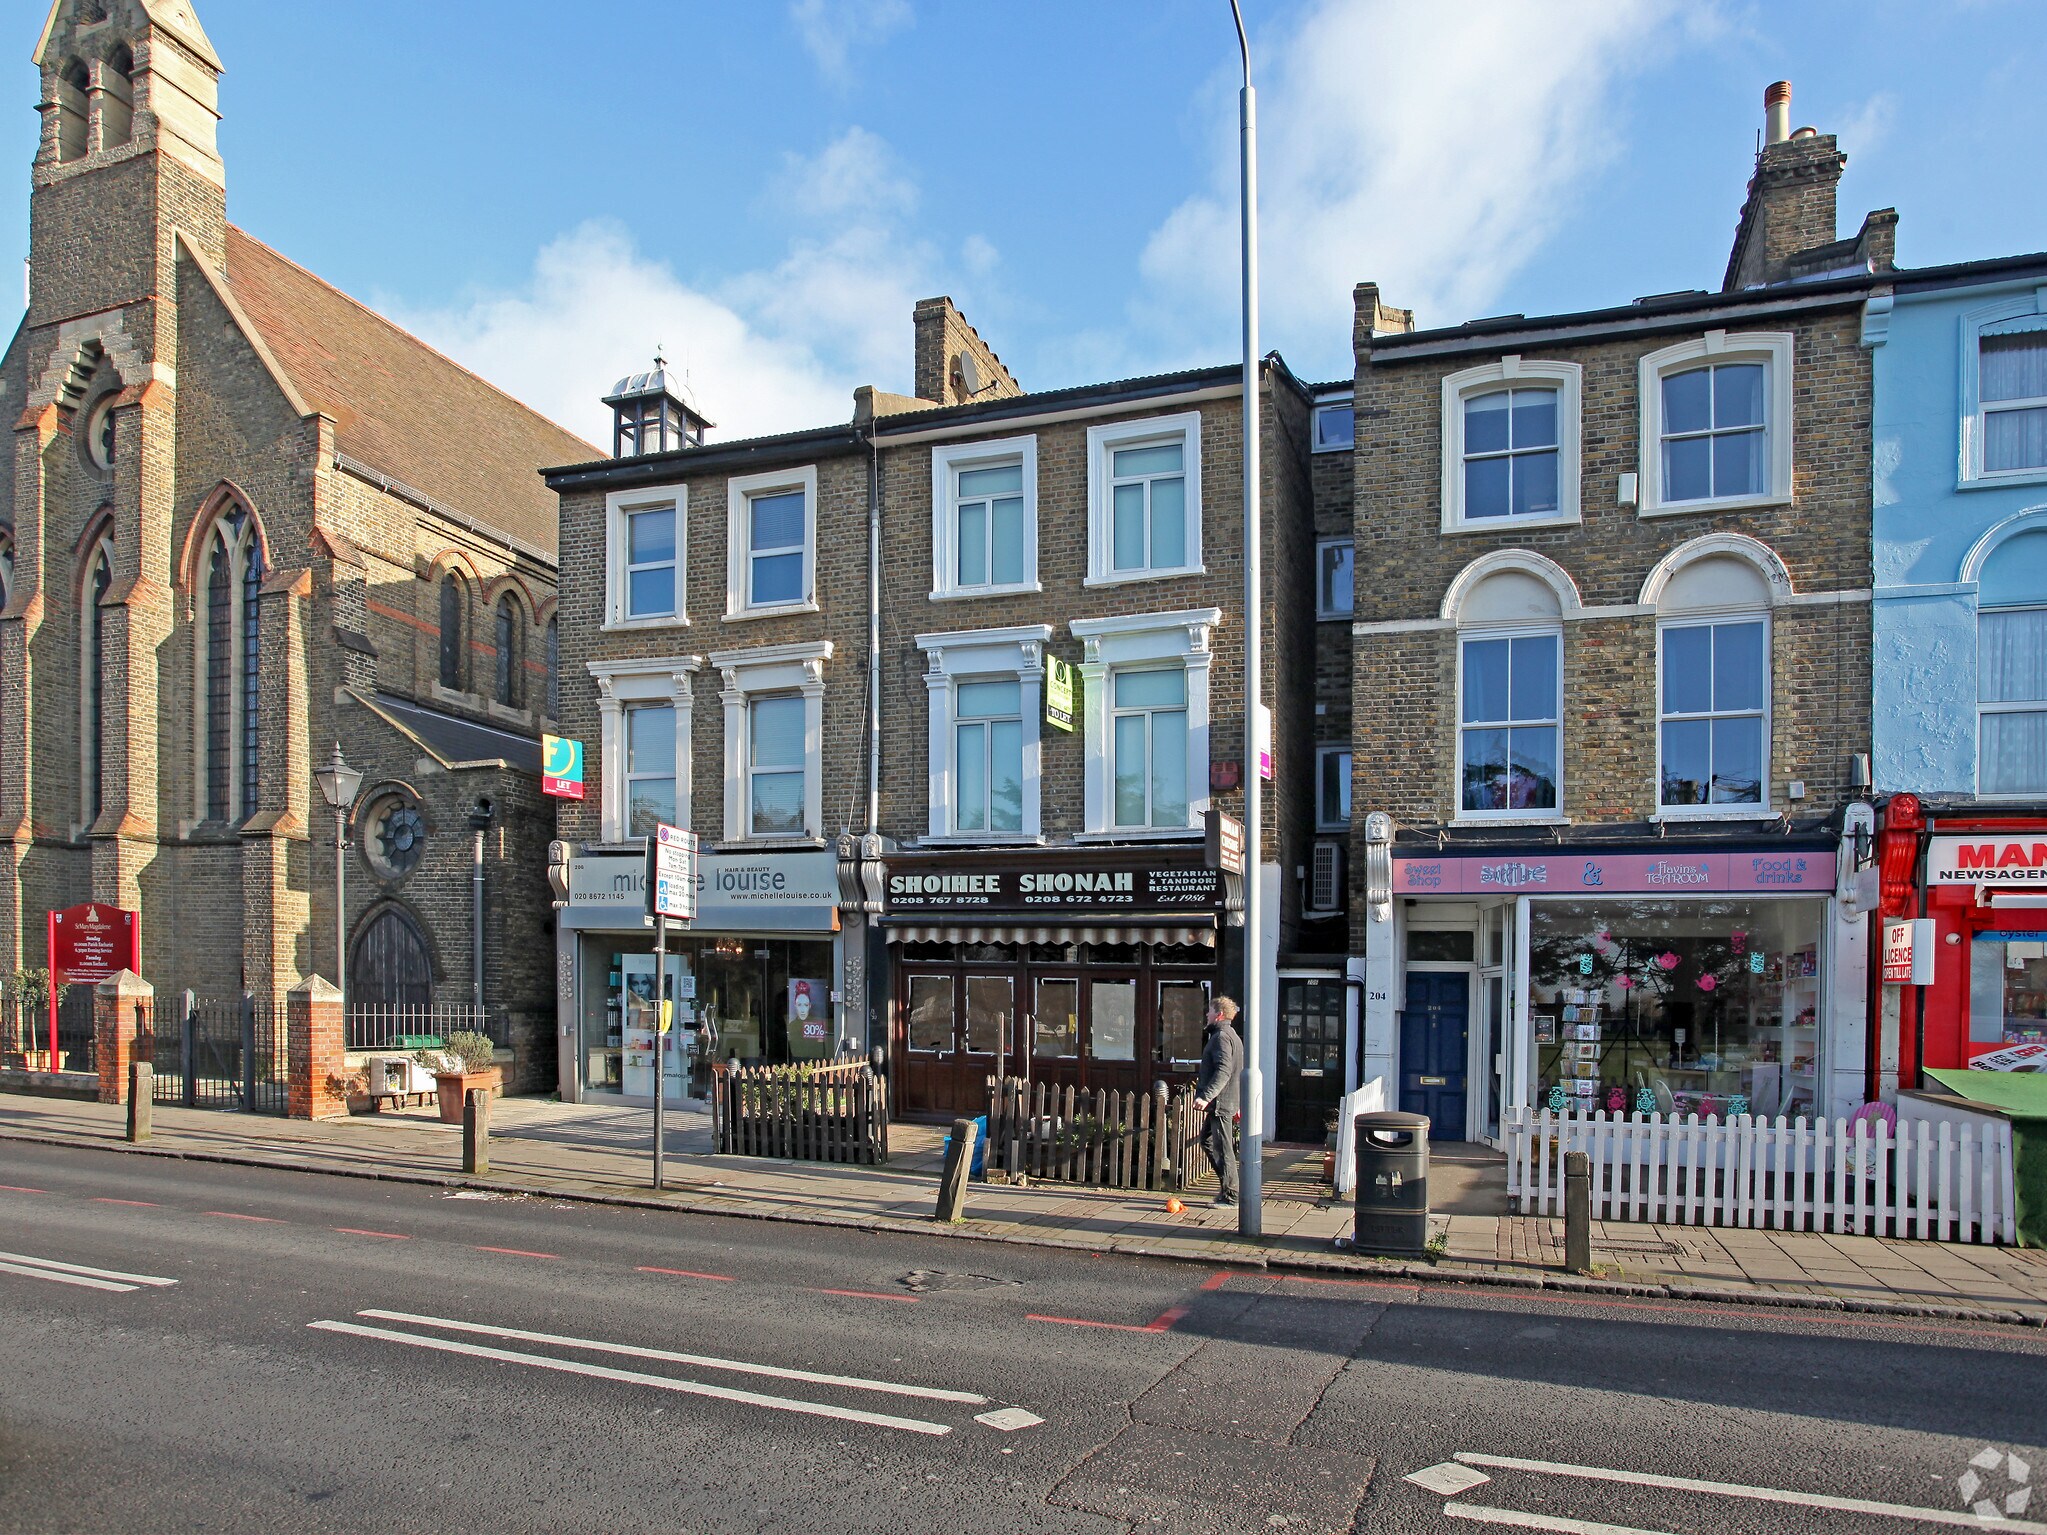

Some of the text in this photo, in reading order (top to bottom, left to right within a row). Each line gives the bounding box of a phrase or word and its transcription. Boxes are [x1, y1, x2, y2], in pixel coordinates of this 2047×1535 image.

[1051, 707, 1070, 723] TO LET
[557, 780, 571, 789] LET
[670, 834, 696, 846] RED ROUTE
[1404, 863, 1441, 876] Sweet
[1752, 858, 1807, 871] Food &
[716, 868, 785, 891] louise
[1149, 870, 1217, 878] VEGETARIAN
[1582, 861, 1603, 886] &
[1755, 870, 1803, 884] drinks
[890, 872, 1133, 894] SHOIHEE SHONAH
[1161, 877, 1216, 885] TANDOORI
[1407, 874, 1441, 888] Shop
[1149, 884, 1216, 892] RESTAURANT
[731, 892, 832, 900] www.michellelouise.co.uk
[929, 896, 952, 904] 767
[956, 896, 989, 904] 8728
[1025, 895, 1134, 903] 0208 672 4723
[1157, 894, 1206, 903] Est 1986
[1892, 928, 1904, 943] OFF
[1884, 946, 1912, 963] LICENCE
[1884, 967, 1911, 978] OPEN TILL LATE
[1370, 991, 1386, 1000] 204
[804, 1024, 825, 1036] 30%
